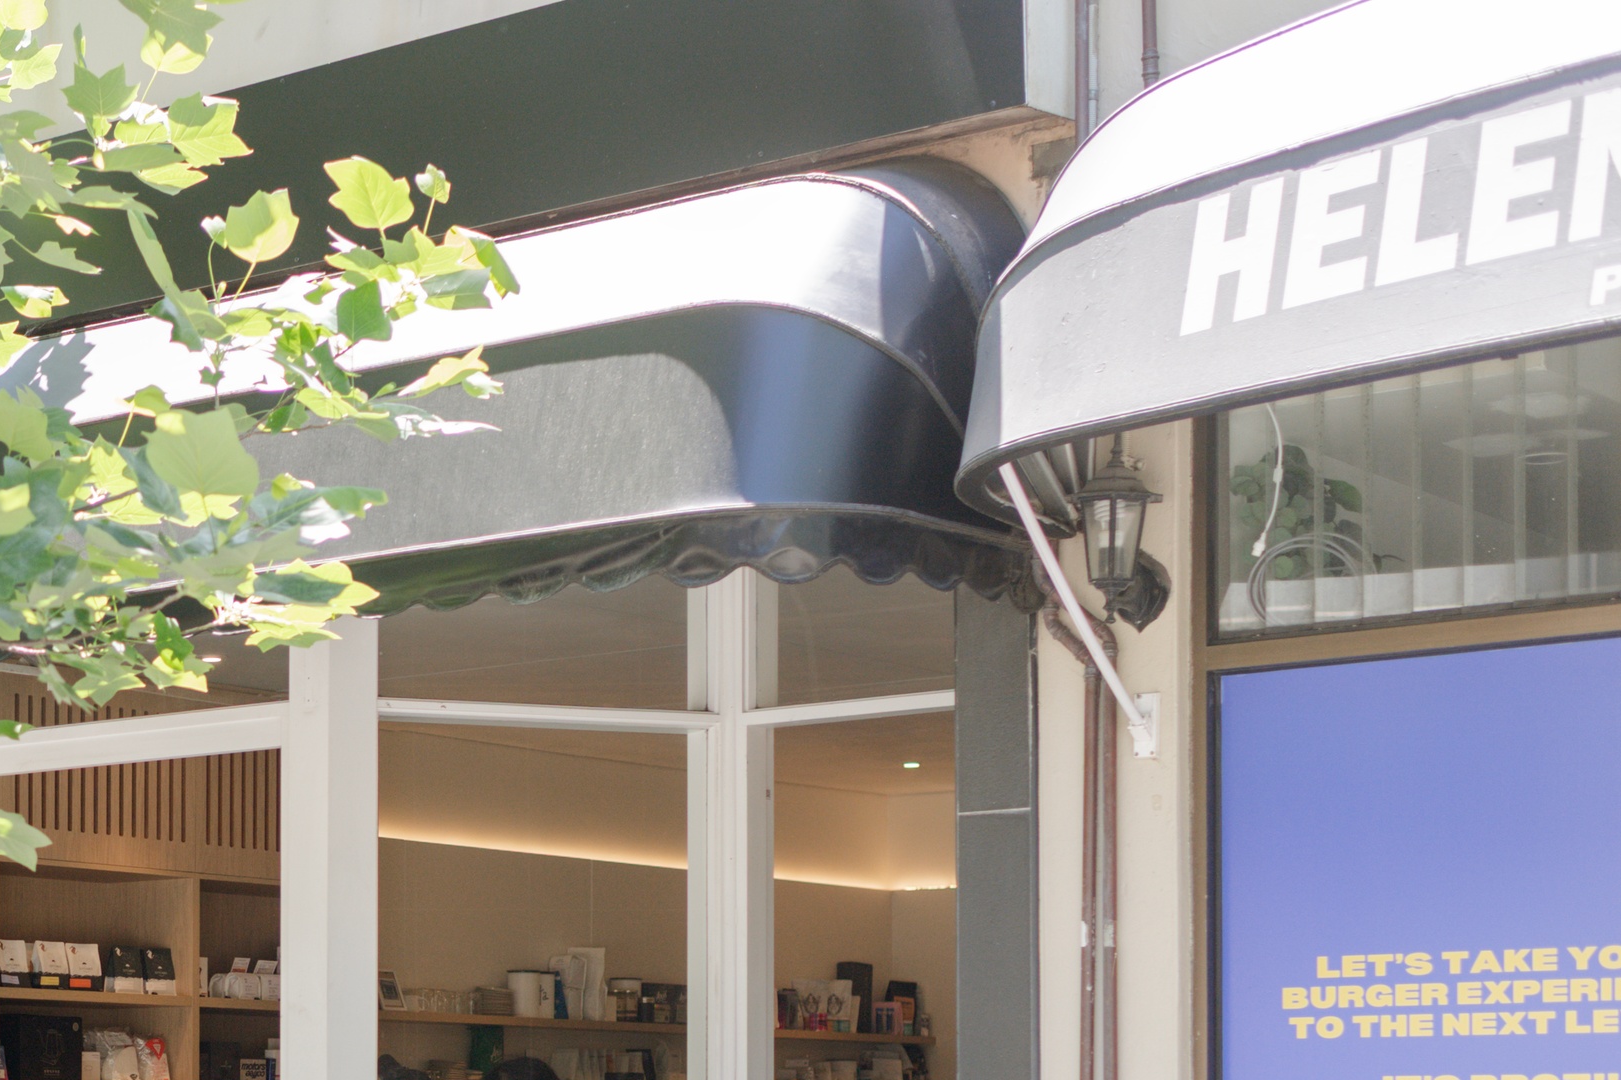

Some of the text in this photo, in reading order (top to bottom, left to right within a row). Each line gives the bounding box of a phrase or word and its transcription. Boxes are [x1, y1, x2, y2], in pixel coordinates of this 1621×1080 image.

[1441, 948, 1558, 975] TAKE
[1567, 945, 1621, 971] YO
[1282, 977, 1621, 1010] BURGER EXPERI
[1288, 1015, 1345, 1039] TO
[1352, 1013, 1434, 1038] THE
[1441, 1010, 1556, 1037] NEXT
